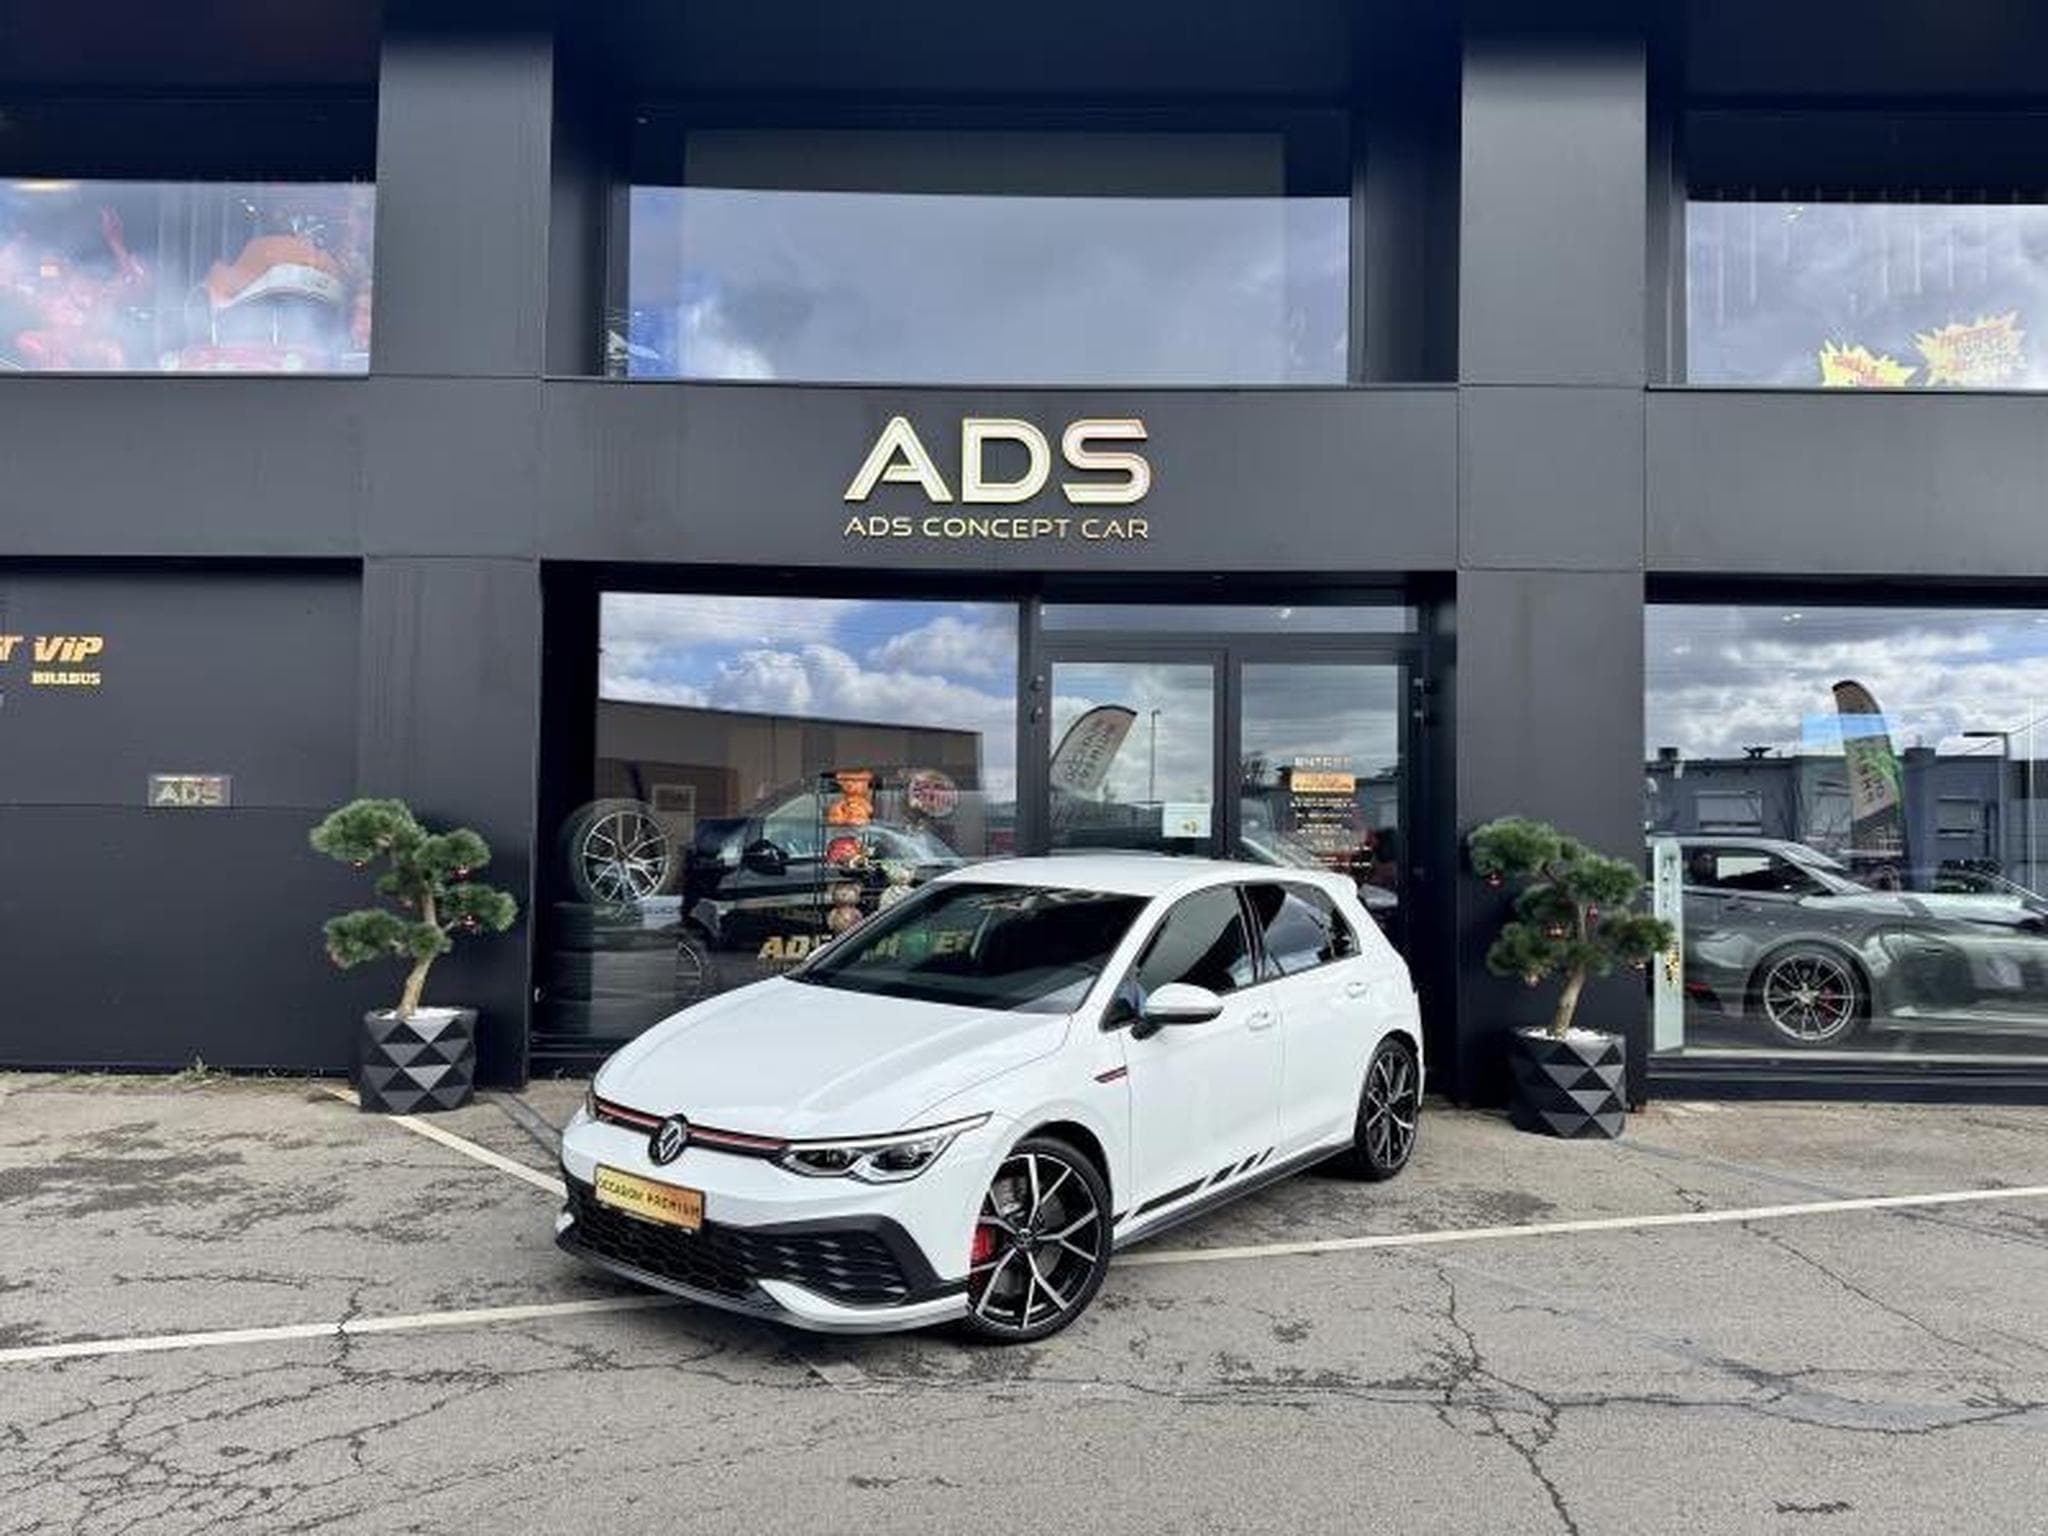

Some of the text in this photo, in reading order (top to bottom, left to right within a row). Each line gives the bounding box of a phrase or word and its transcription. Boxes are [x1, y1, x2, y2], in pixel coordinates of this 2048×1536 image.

[843, 415, 1151, 503] ADS
[843, 516, 1149, 539] ADS CONCEPT CAR
[155, 777, 224, 805] ADS
